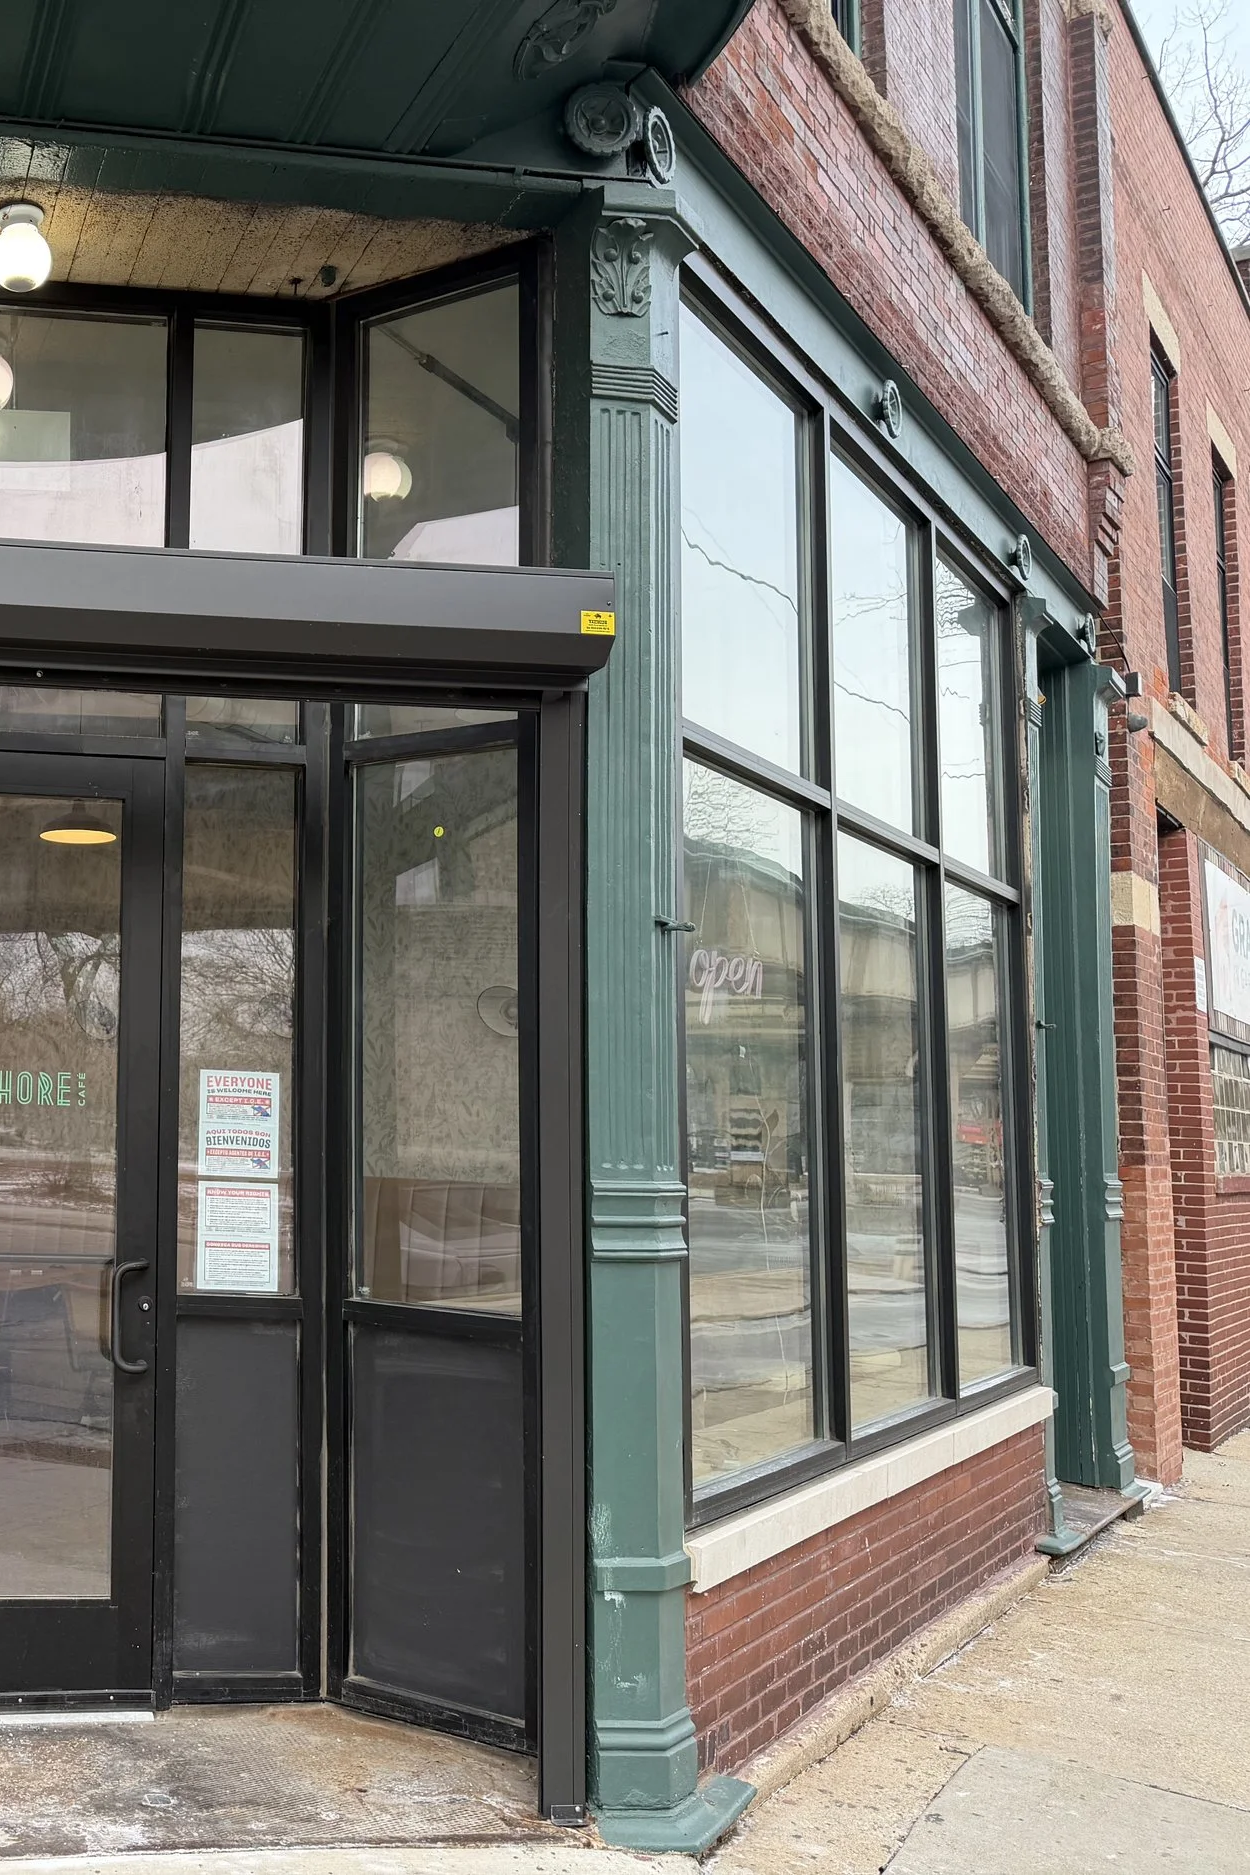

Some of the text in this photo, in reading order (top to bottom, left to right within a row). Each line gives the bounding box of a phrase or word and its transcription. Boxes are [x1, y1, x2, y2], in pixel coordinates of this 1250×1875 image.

[76, 1072, 87, 1107] CAFÉ
[206, 1075, 272, 1091] EVERYONE
[215, 1096, 243, 1104] EXCEPT
[253, 1089, 272, 1097] HERE
[205, 1135, 271, 1149] BIENVENIDOS
